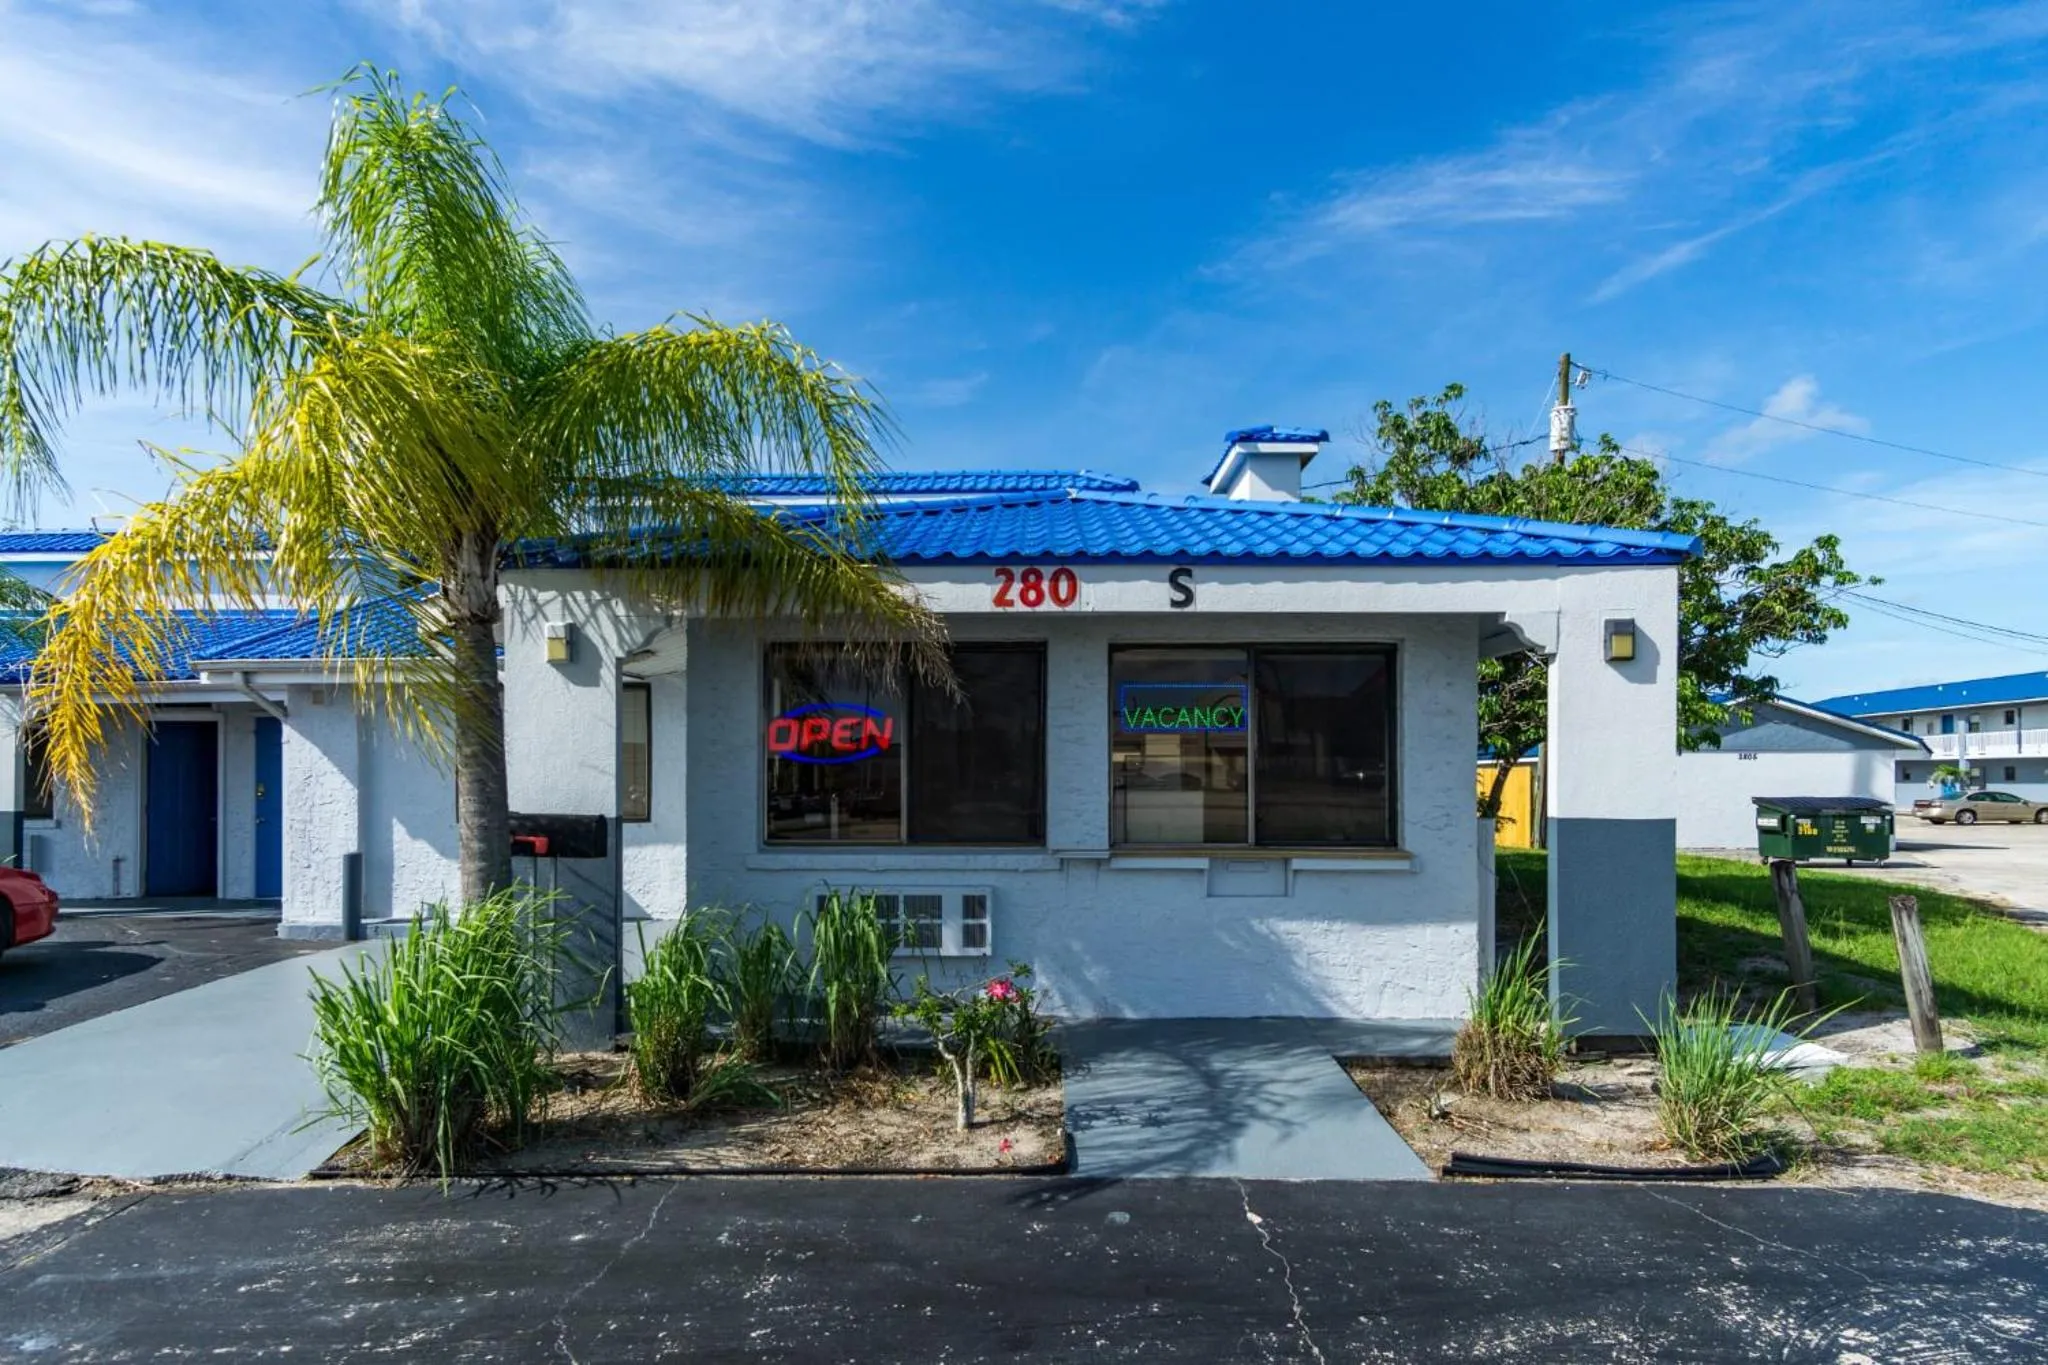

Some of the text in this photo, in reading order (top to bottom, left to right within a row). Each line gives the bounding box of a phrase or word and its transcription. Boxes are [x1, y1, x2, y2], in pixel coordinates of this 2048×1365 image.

[992, 567, 1194, 609] 280 S
[768, 715, 894, 752] OPEN
[1123, 704, 1245, 729] VACANCY
